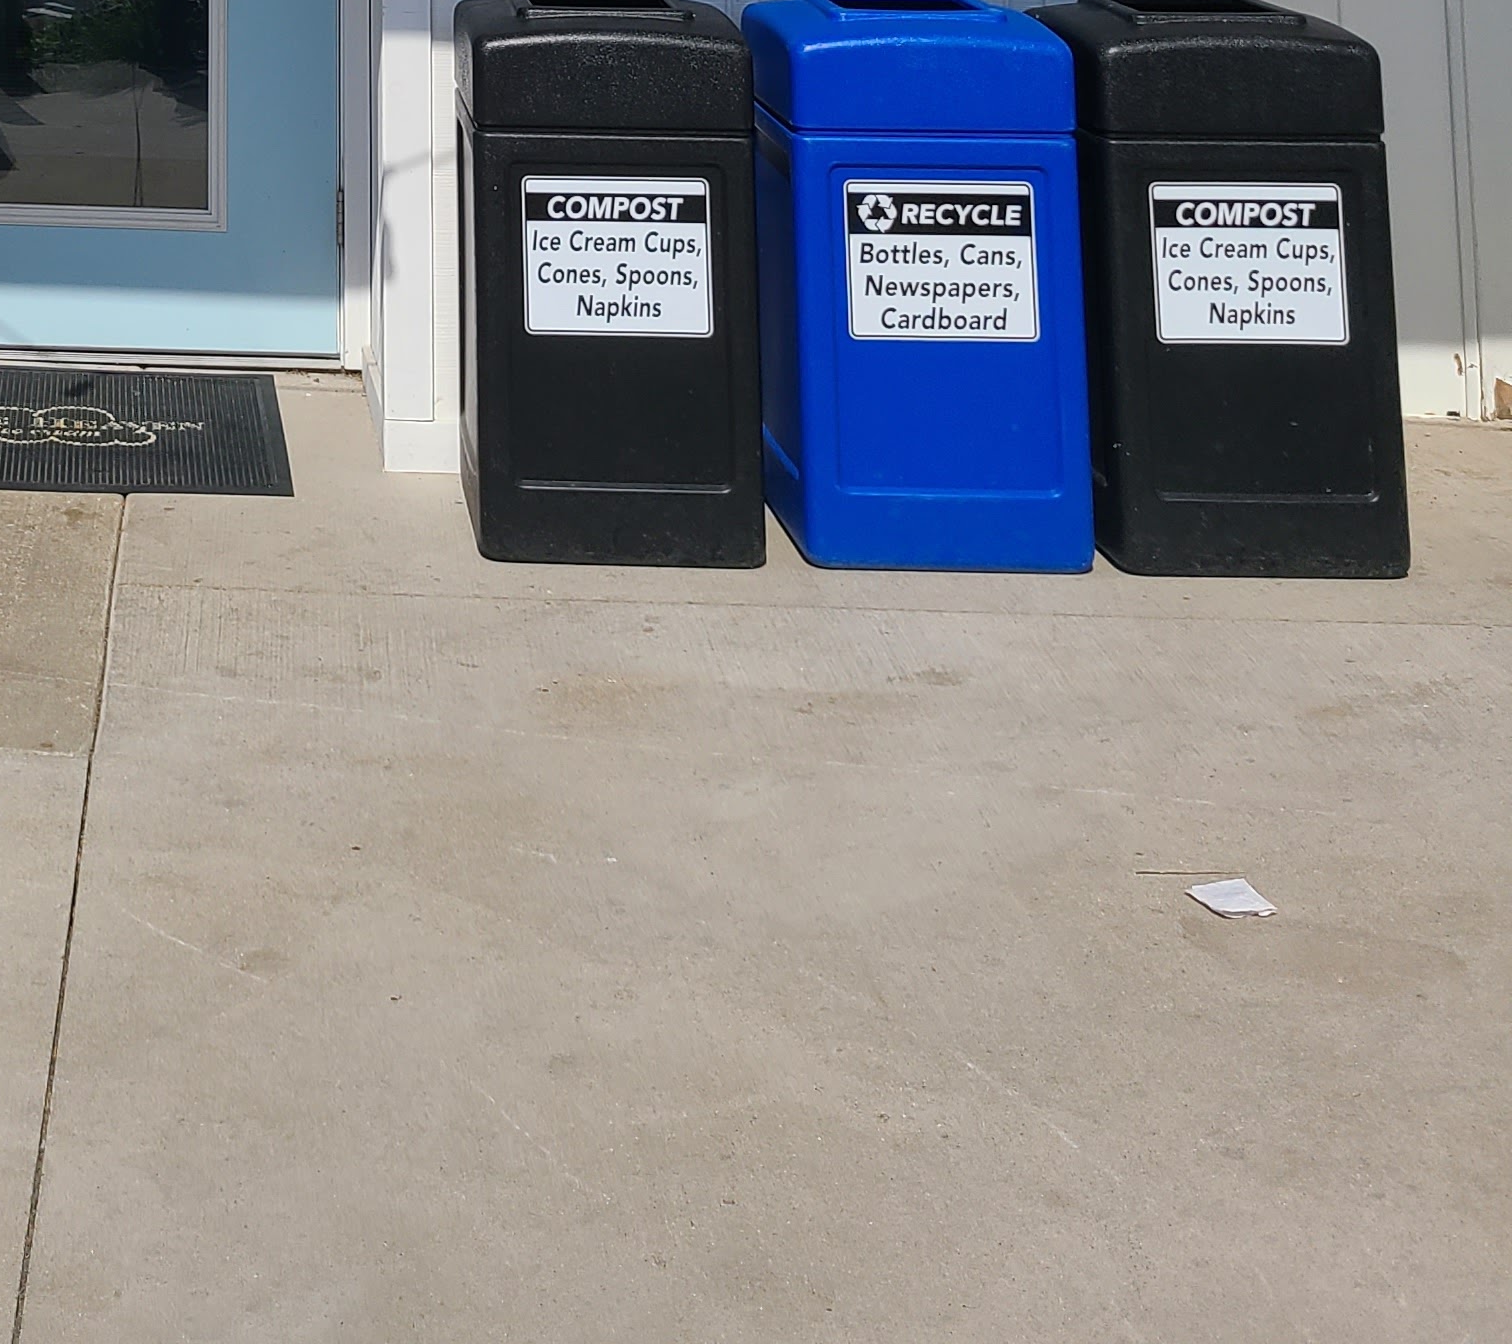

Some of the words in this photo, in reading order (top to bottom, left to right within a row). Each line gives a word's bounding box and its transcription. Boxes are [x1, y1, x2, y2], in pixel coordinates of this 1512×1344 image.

[546, 195, 685, 221] COMPOST
[900, 202, 1023, 226] RECYCLE
[1175, 201, 1316, 227] COMPOST
[531, 229, 561, 252] Ice
[569, 229, 636, 253] Cream
[644, 230, 703, 260] Cups,
[859, 241, 950, 269] Bottles,
[960, 243, 1023, 270] Cans,
[1161, 236, 1191, 259] Ice
[1199, 236, 1268, 259] Cream
[1276, 237, 1336, 266] Cups,
[537, 261, 608, 288] Cones,
[615, 262, 699, 292] Spoons,
[864, 274, 1021, 304] Newspapers,
[1167, 269, 1240, 295] Cones,
[1247, 269, 1333, 298] Spoons,
[575, 294, 662, 324] Napkins
[880, 306, 1008, 331] Cardboard
[1208, 301, 1296, 331] Napkins
